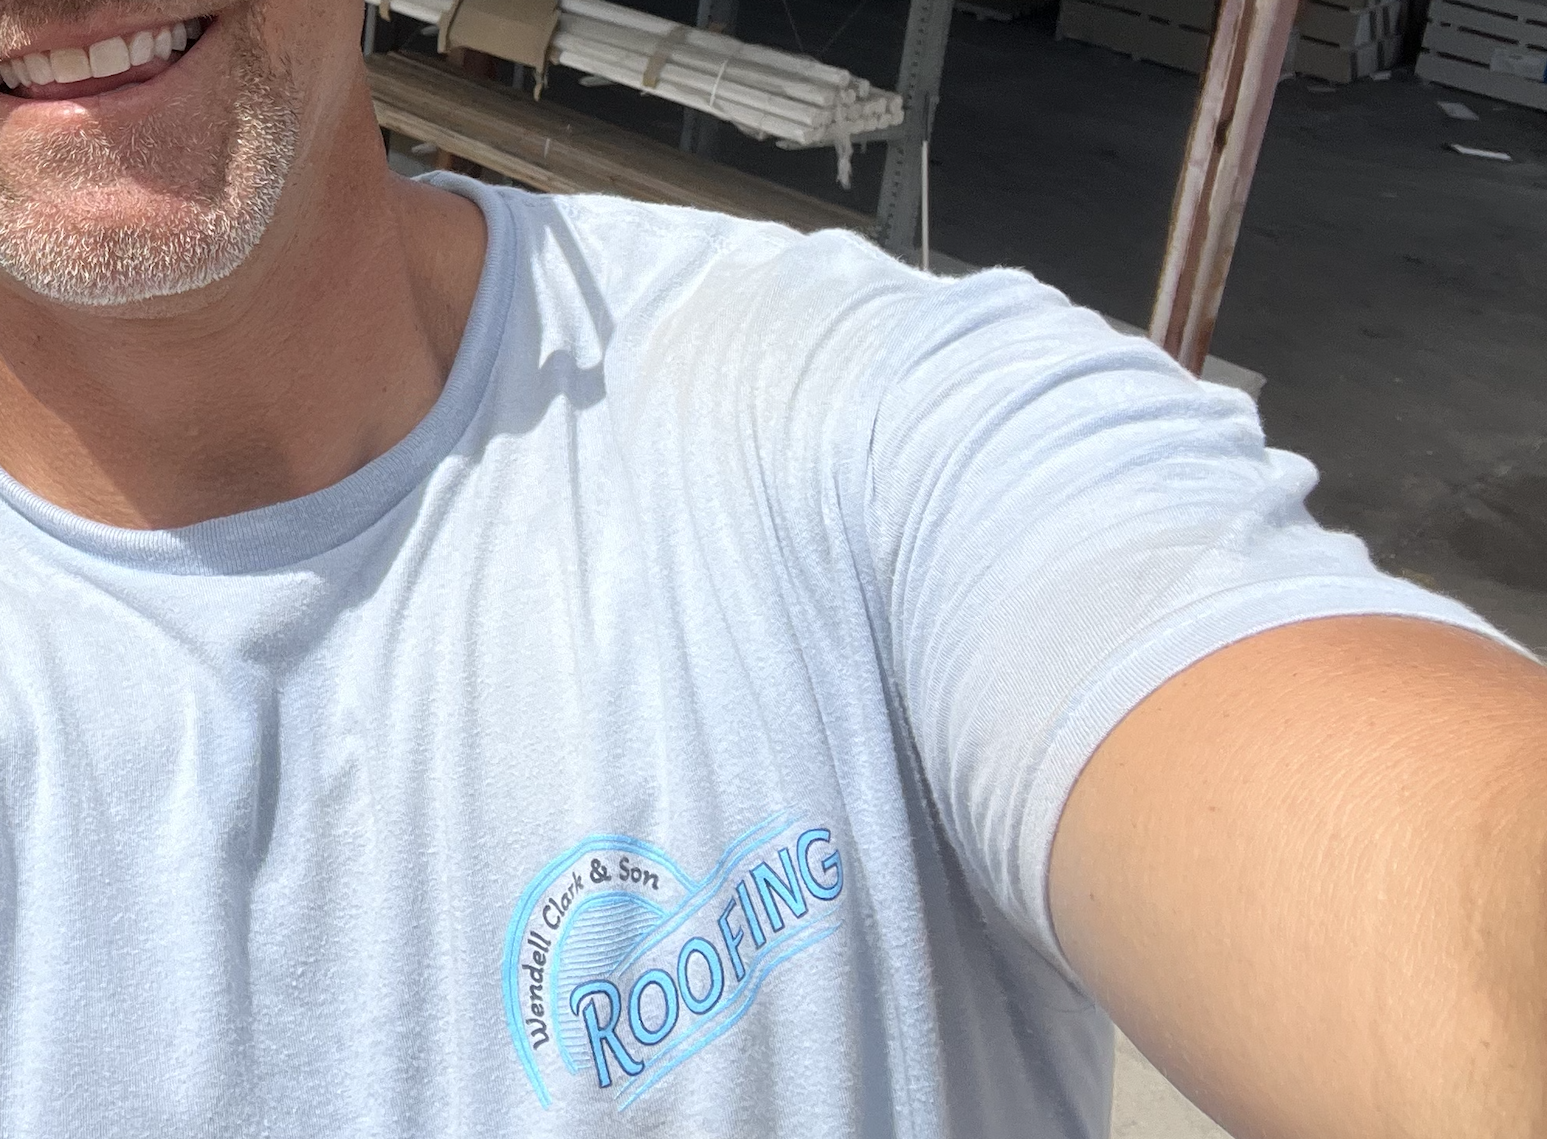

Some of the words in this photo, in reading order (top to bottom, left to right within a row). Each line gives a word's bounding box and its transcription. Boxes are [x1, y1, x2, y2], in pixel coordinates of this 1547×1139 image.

[522, 930, 551, 1051] Wendell
[542, 871, 585, 930] Clark
[589, 858, 612, 884] &
[618, 857, 660, 891] Son
[570, 827, 844, 1088] ROOFING
